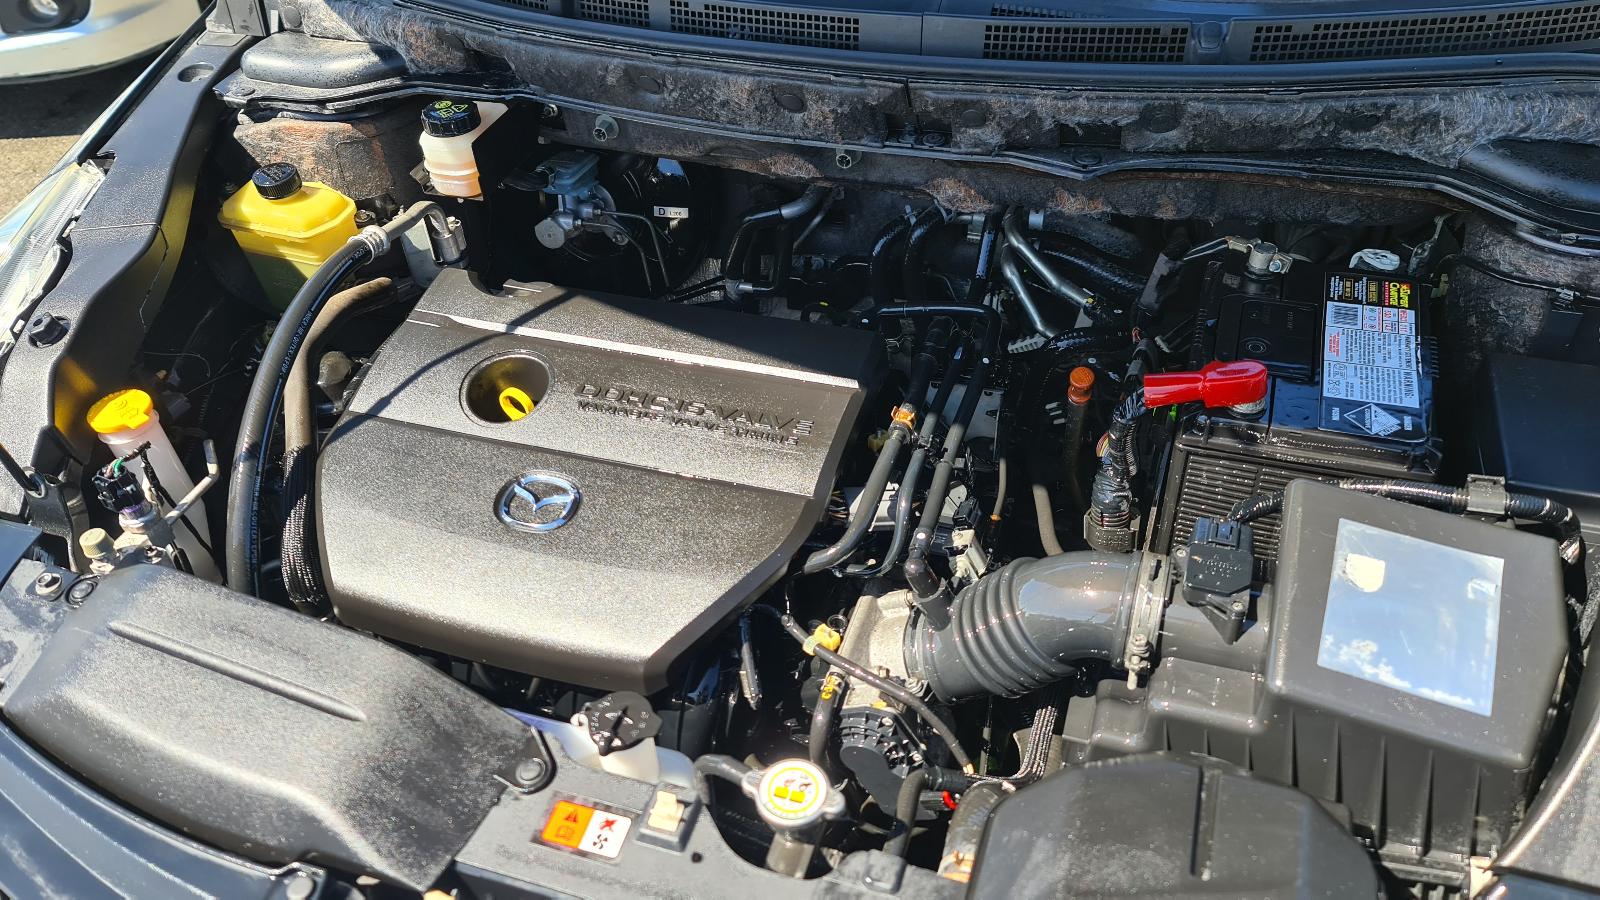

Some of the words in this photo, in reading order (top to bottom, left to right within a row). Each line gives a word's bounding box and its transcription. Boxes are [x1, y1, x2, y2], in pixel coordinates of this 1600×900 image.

[658, 207, 666, 216] D
[1403, 371, 1414, 398] WARNING:
[574, 383, 671, 410] DOHC
[669, 415, 728, 434] VALVE
